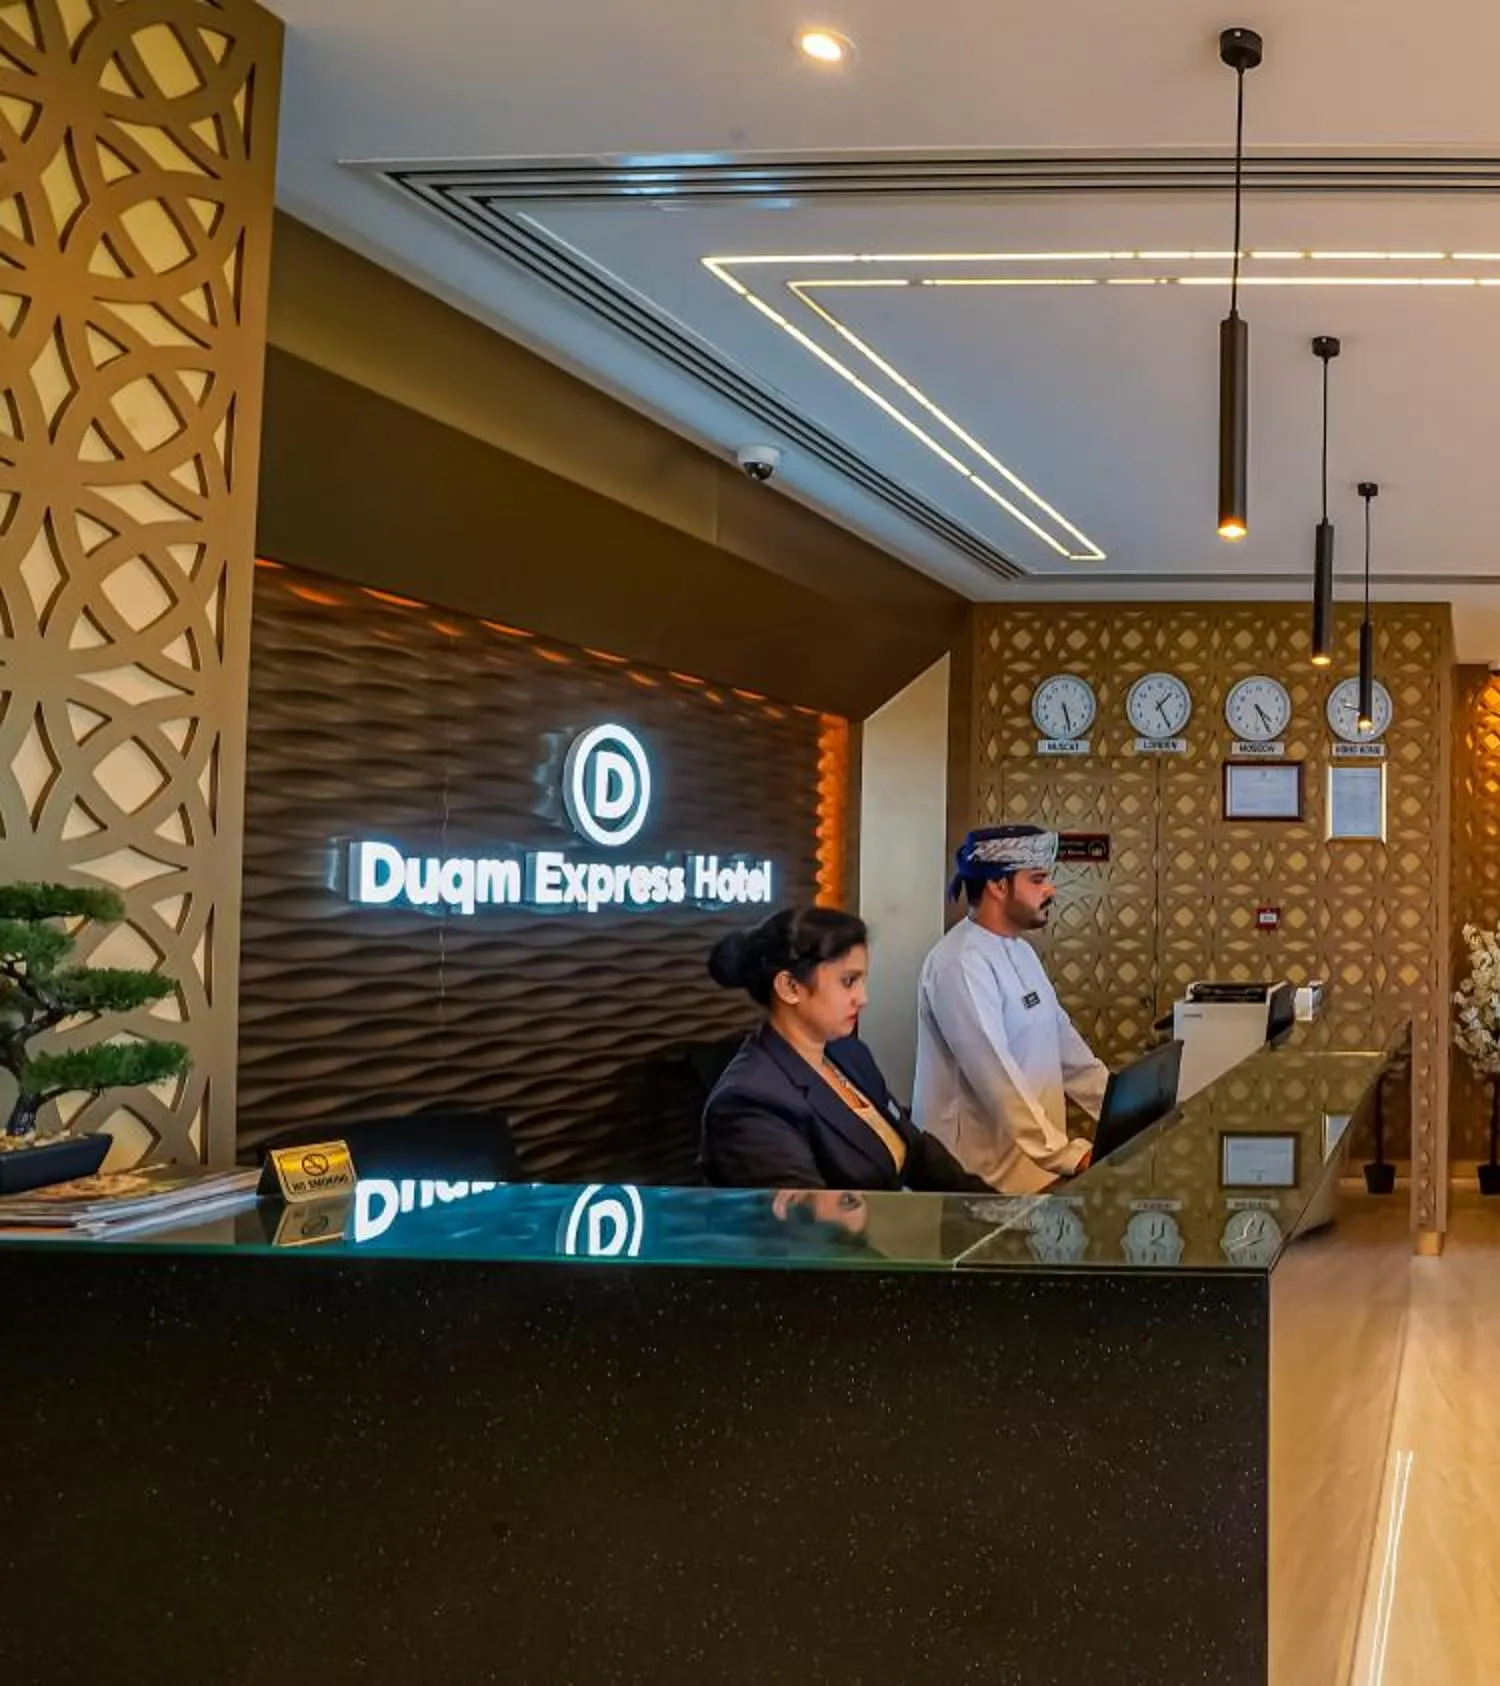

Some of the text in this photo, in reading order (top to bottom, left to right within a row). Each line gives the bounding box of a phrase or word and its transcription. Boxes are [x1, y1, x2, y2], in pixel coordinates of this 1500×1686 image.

[593, 750, 636, 819] D
[360, 841, 773, 915] Duqm Express Hotel
